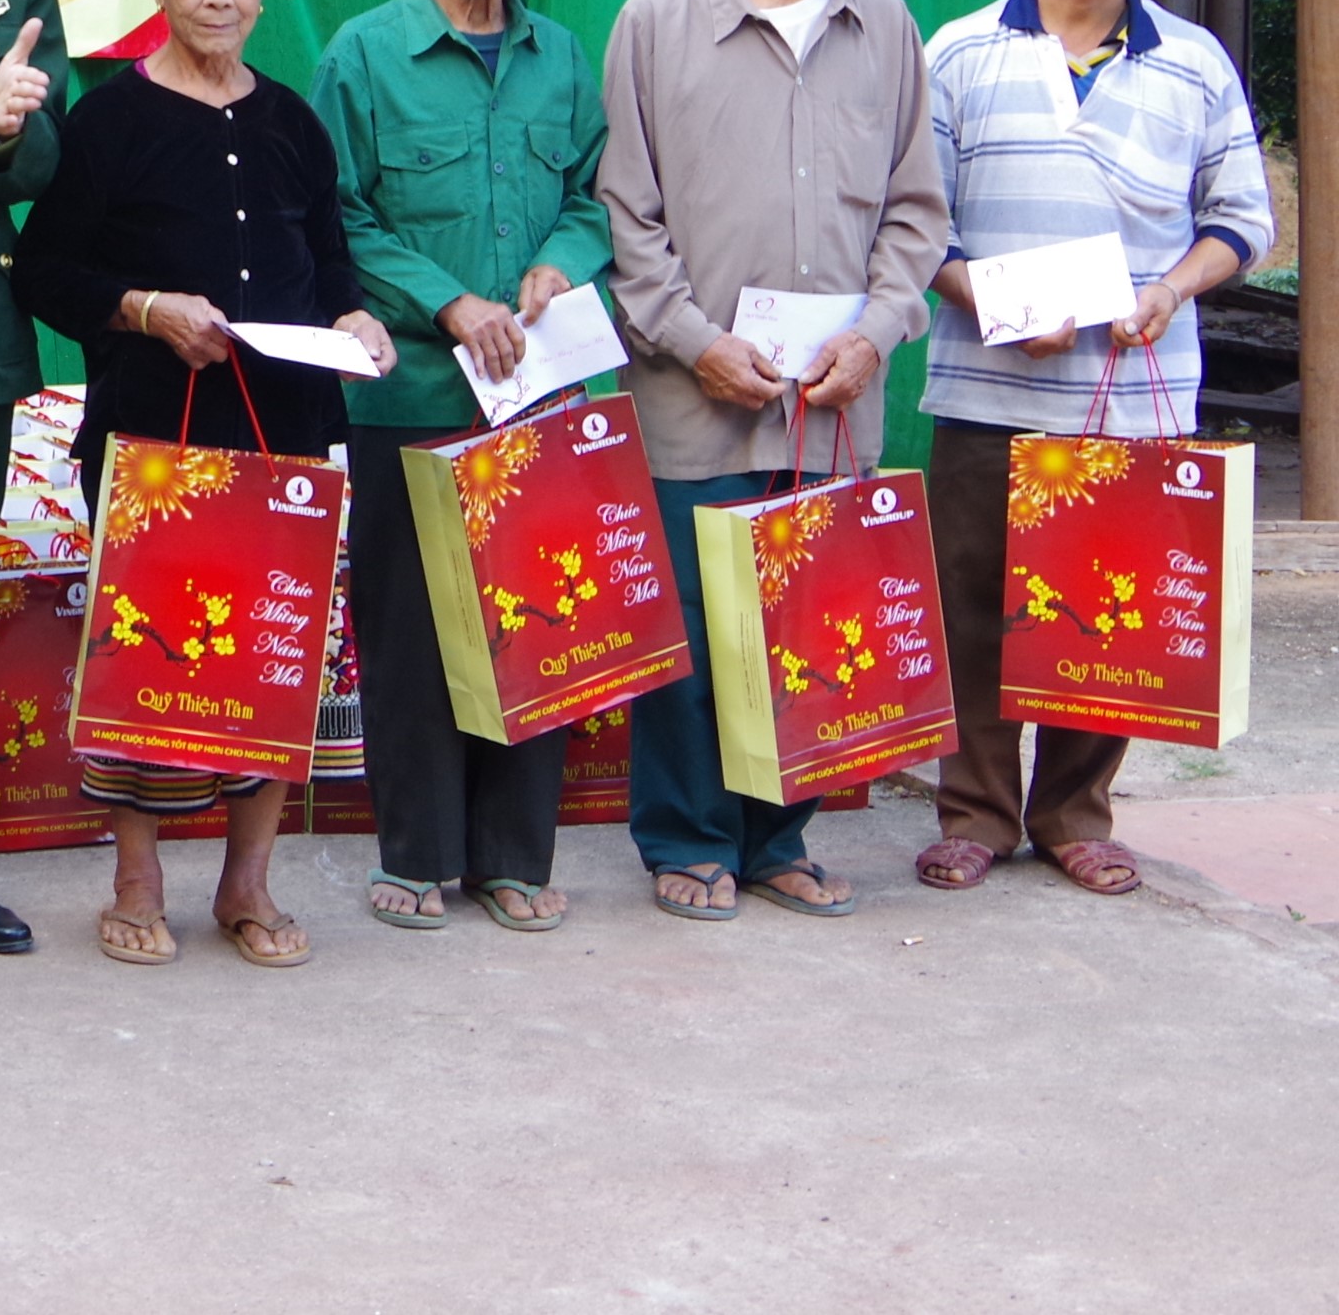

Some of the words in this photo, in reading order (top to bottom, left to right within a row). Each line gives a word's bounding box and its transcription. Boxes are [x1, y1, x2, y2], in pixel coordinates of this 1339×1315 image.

[596, 502, 639, 524] Chúc
[1166, 549, 1207, 574] Chúc
[267, 570, 313, 597] Chúc
[878, 576, 920, 598] Chúc
[539, 652, 567, 676] Quỹ
[569, 641, 606, 664] Thiện
[604, 631, 632, 650] Tâm
[1056, 659, 1089, 683] Quỹ
[1093, 663, 1132, 687] Thiện
[1135, 668, 1163, 689] Tâm
[136, 687, 172, 713] Quỹ
[177, 692, 219, 717] Thiện
[223, 697, 253, 720] Tâm
[816, 719, 843, 743] Quỹ
[844, 710, 878, 731] Thiện
[878, 703, 904, 720] Tâm
[223, 747, 244, 757] CHO
